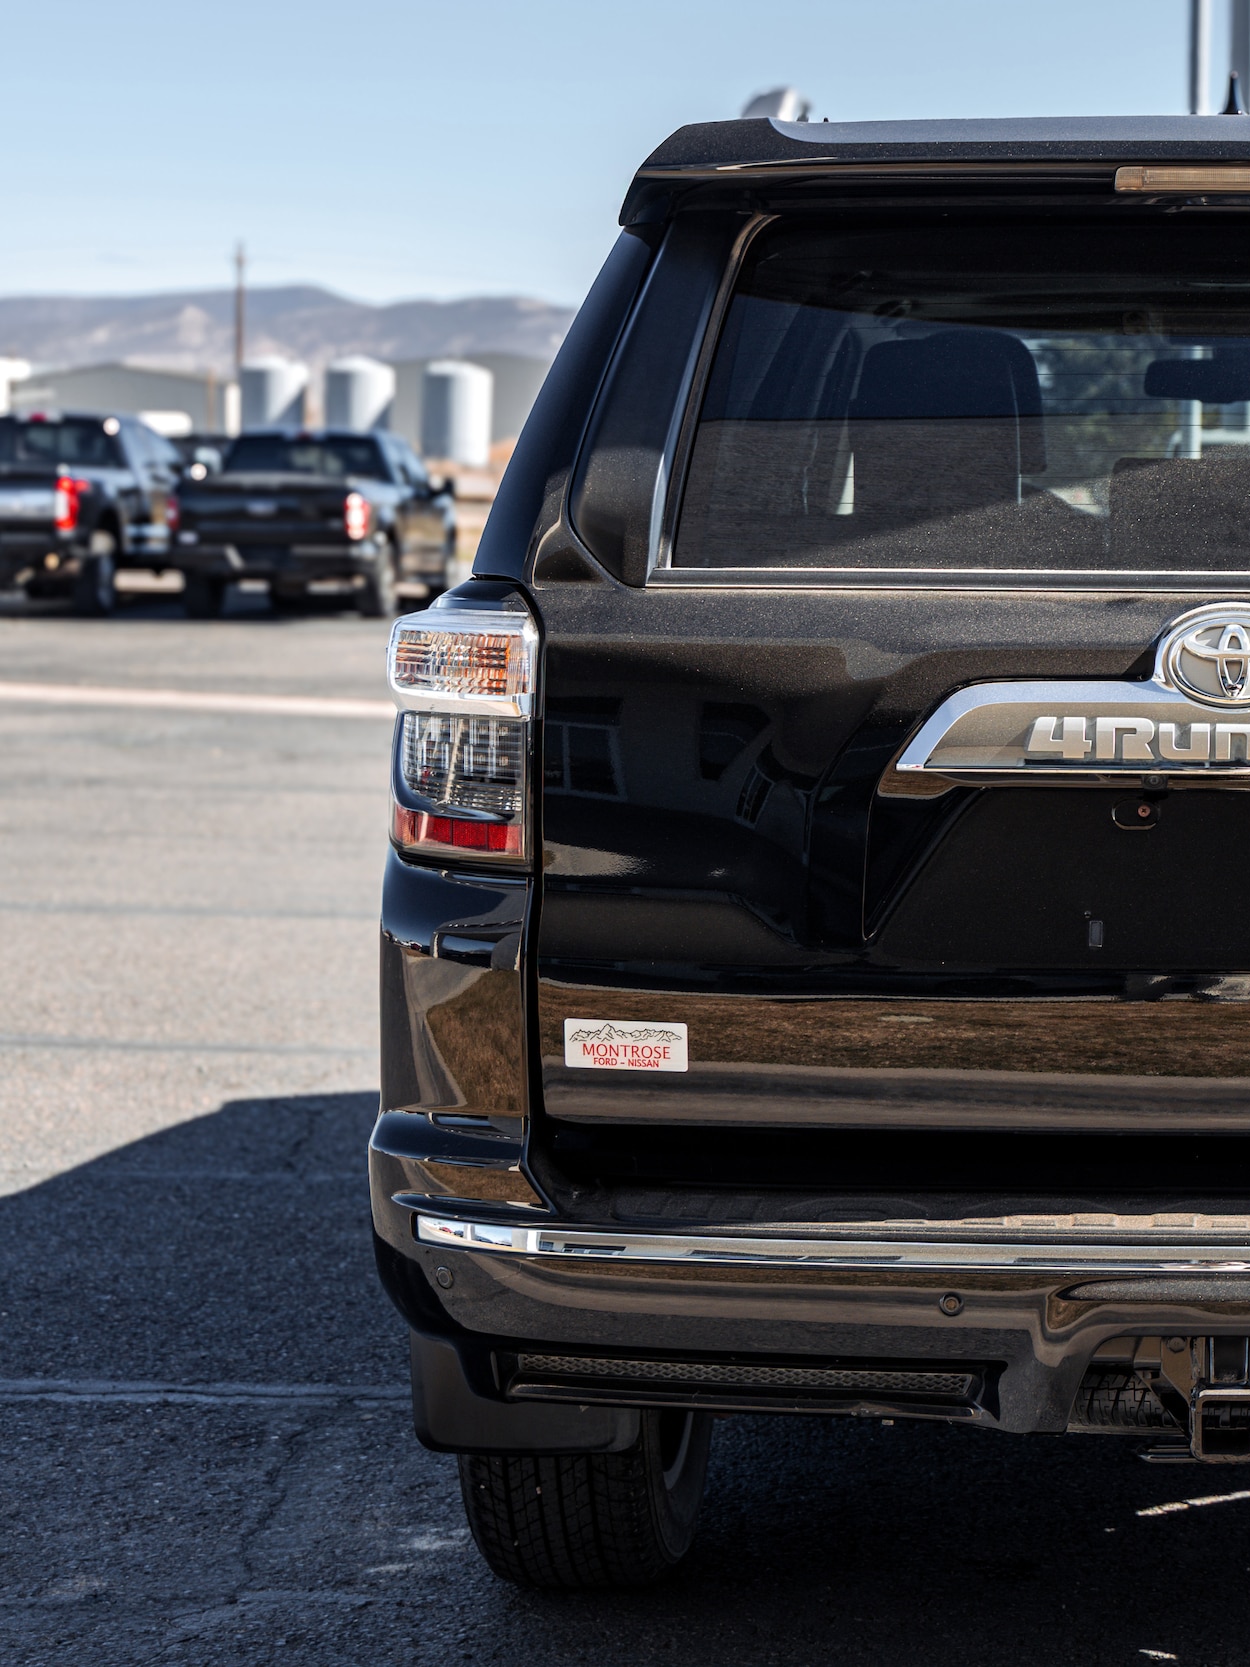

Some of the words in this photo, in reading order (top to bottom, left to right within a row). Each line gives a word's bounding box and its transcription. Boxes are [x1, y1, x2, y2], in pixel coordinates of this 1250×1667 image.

[582, 1043, 671, 1059] MONTROSE
[593, 1057, 618, 1066] FORD
[627, 1059, 660, 1068] NISSAN
